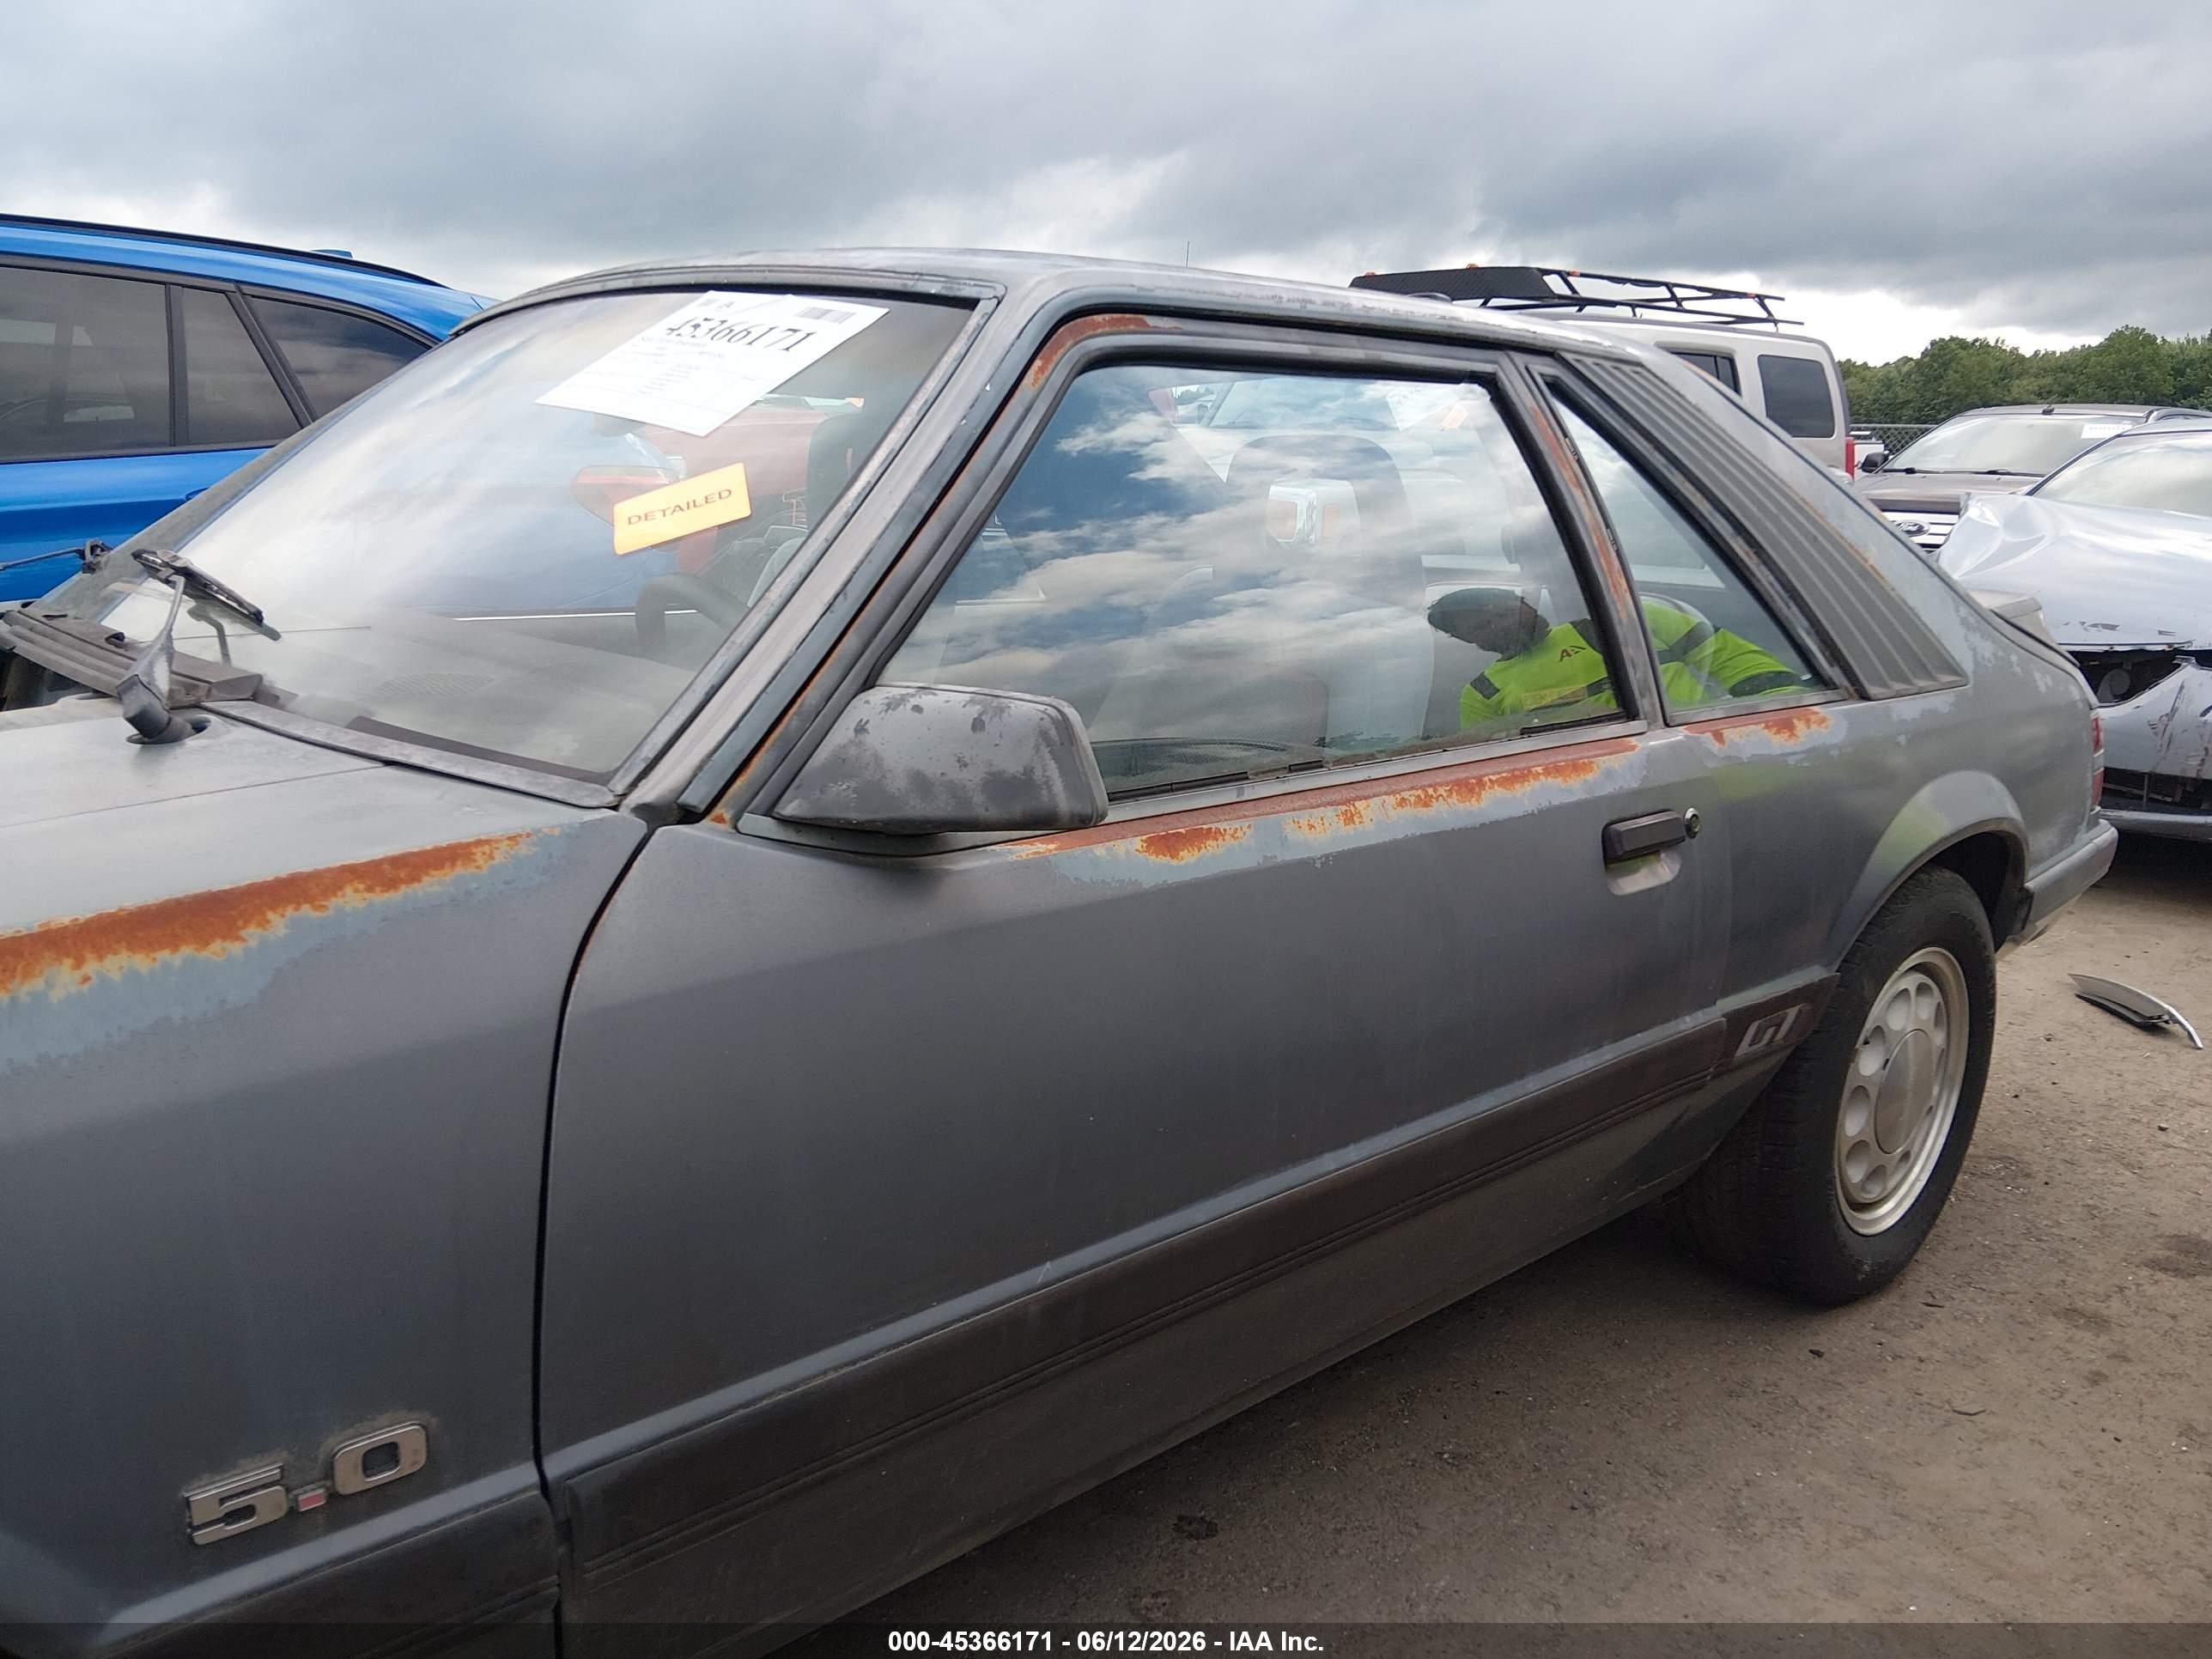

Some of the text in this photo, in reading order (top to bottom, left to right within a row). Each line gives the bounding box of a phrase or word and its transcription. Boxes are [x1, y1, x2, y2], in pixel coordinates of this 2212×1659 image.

[665, 316, 817, 352] 45366171
[627, 488, 732, 526] DETAILED
[1734, 1003, 1813, 1058] GT
[183, 1420, 428, 1546] 5.0
